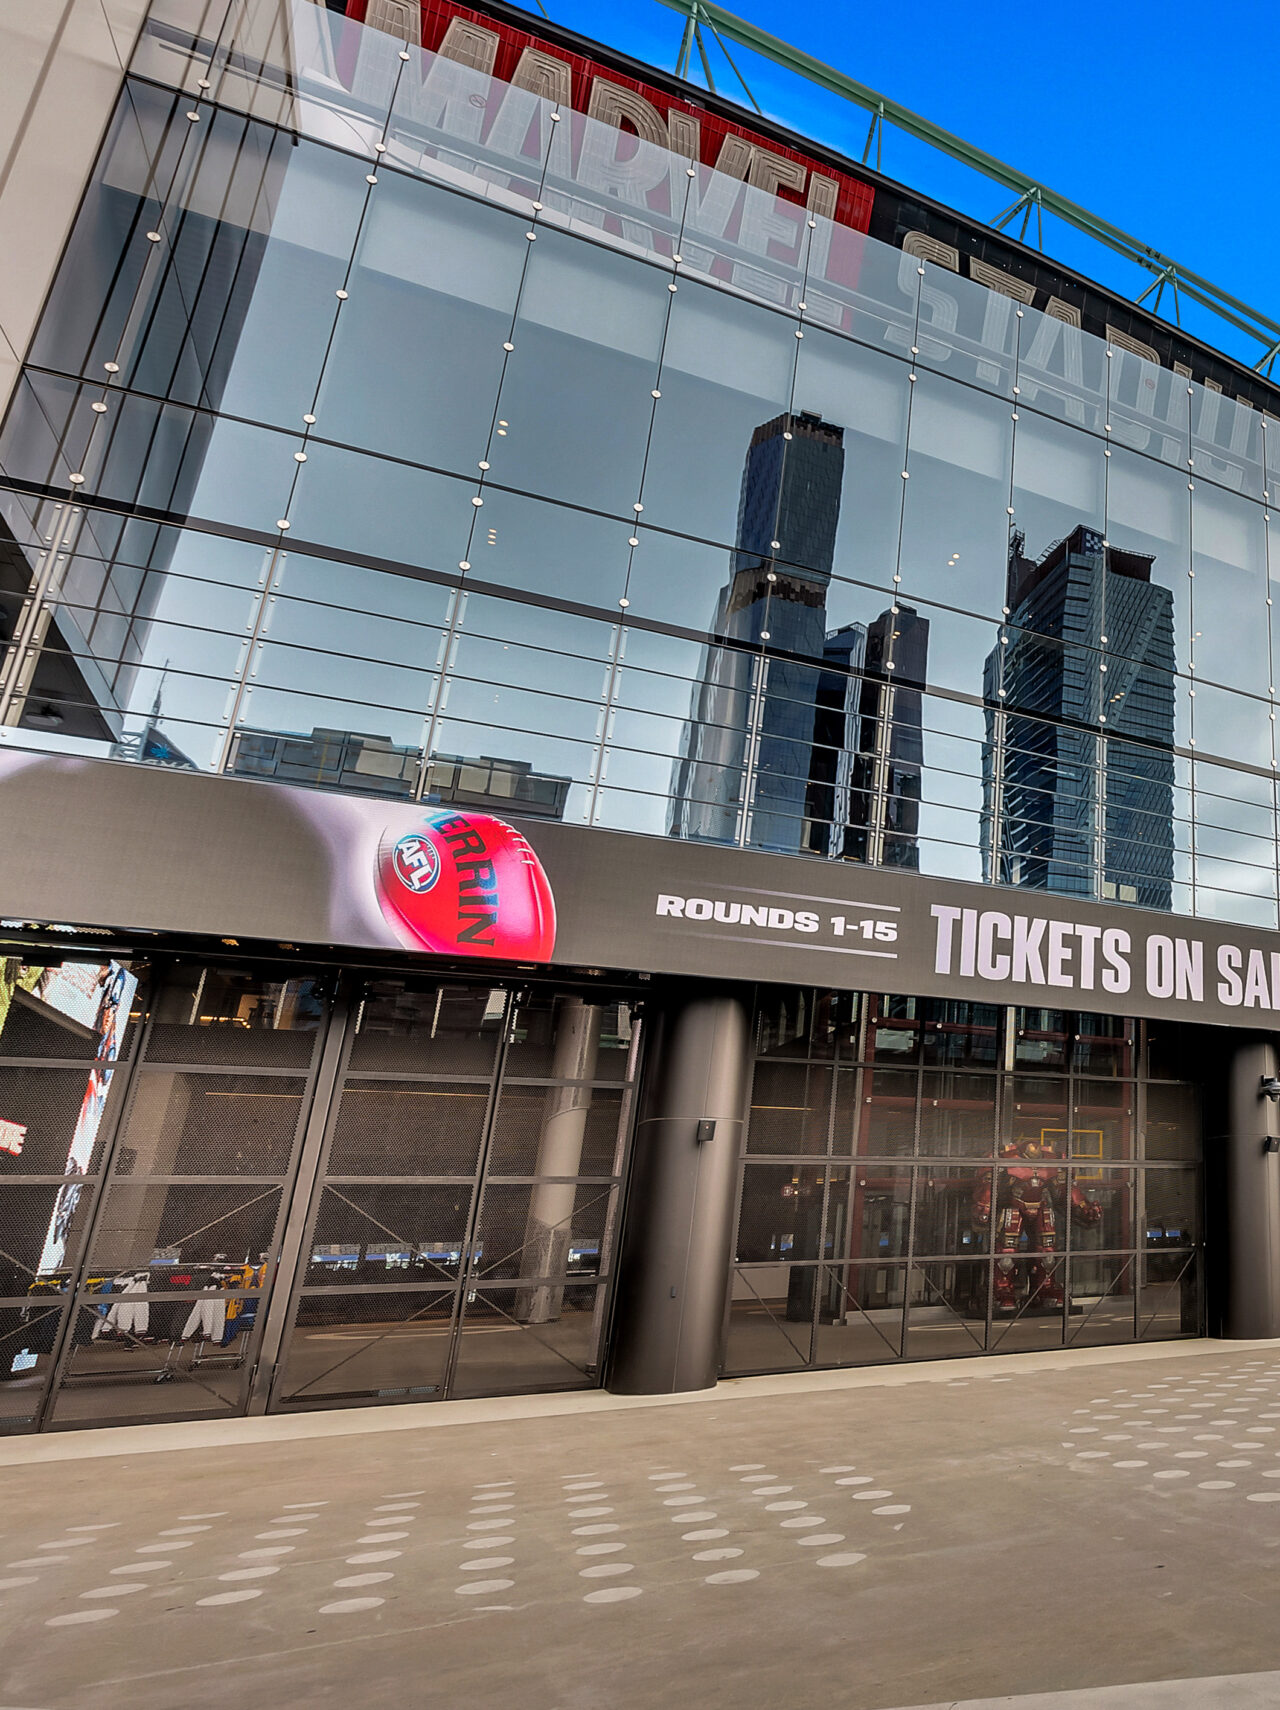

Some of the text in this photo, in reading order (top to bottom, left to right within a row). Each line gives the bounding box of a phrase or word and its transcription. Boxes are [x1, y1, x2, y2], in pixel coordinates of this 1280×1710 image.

[348, 0, 844, 326] MARVEL
[397, 839, 433, 890] AFL
[656, 894, 898, 942] ROUNDS 1-15
[930, 904, 1131, 994] TICKETS
[1146, 934, 1204, 1002] ON
